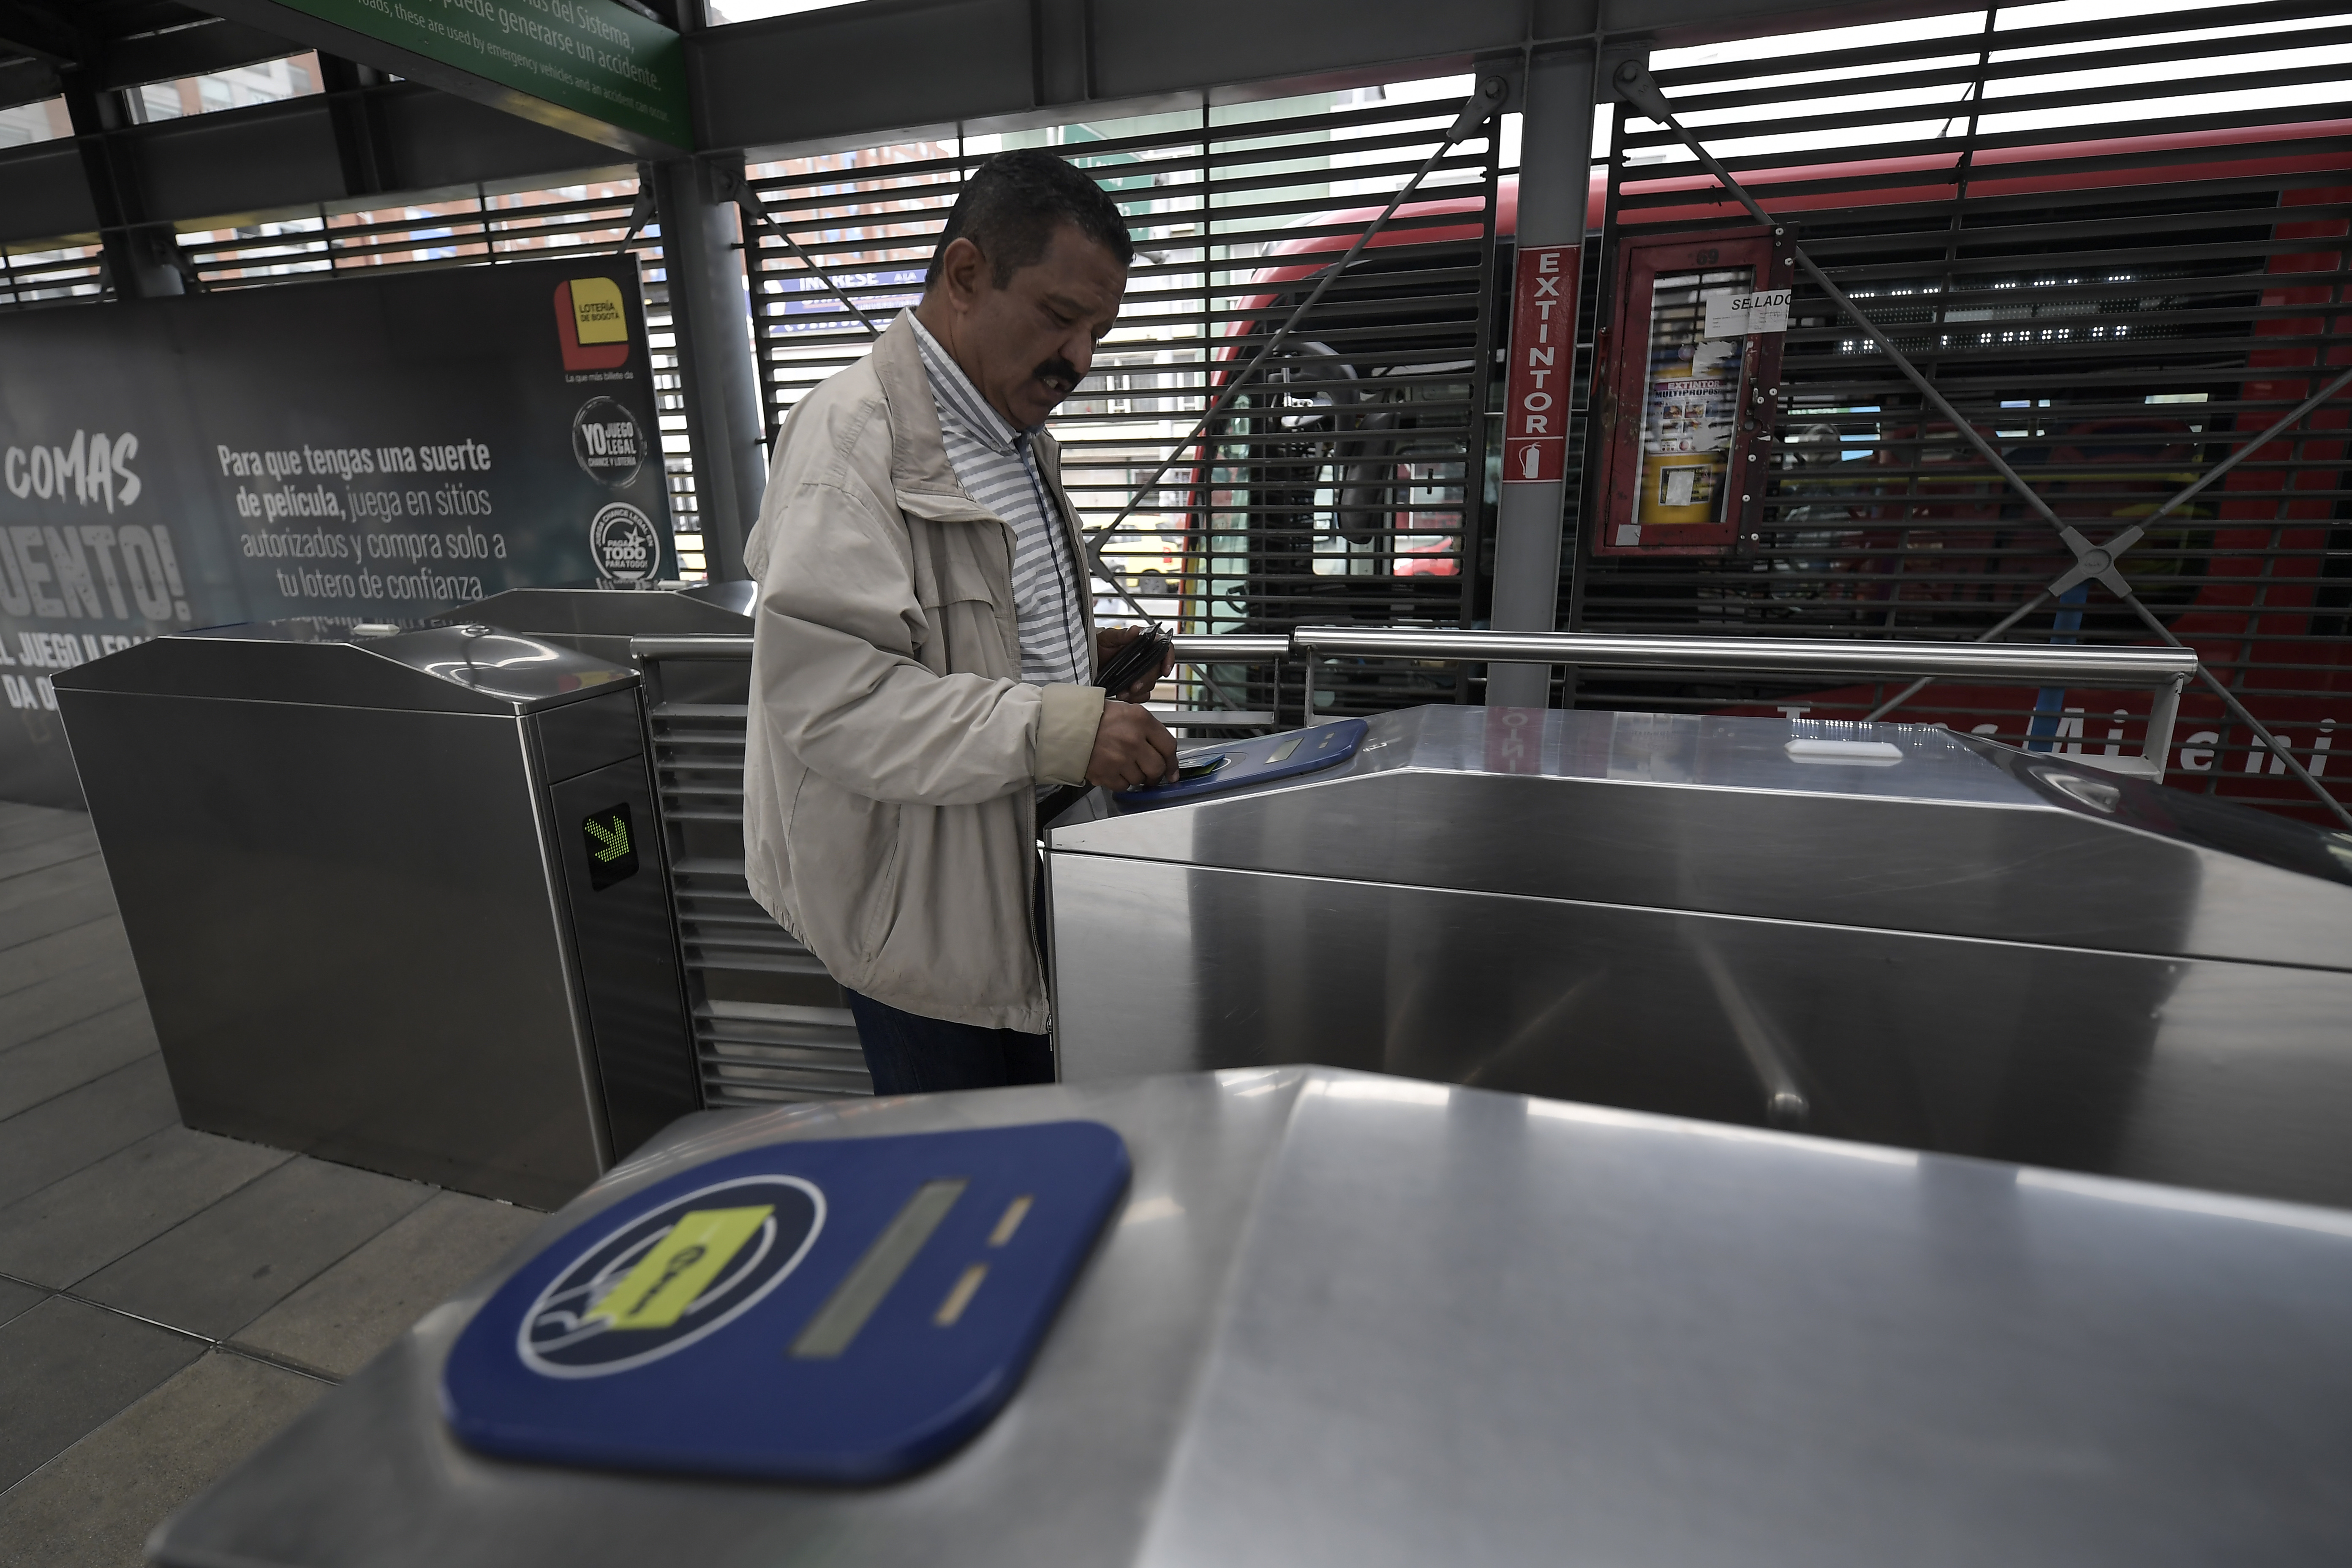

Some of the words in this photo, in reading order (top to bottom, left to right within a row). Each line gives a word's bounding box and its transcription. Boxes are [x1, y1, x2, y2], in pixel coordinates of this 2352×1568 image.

[394, 3, 425, 28] these
[428, 19, 445, 35] are
[447, 27, 471, 45] used
[472, 33, 485, 54] by
[487, 43, 537, 74] emergency
[552, 0, 574, 24] del
[577, 6, 634, 54] Sistema,
[499, 8, 574, 54] generarse
[576, 41, 595, 63] un
[598, 50, 661, 91] accidente.
[579, 300, 615, 313] LOTERÍA
[581, 314, 590, 322] DE
[1524, 253, 1560, 434] EXTINTOR
[1668, 381, 1720, 389] EXTINTOR
[581, 422, 607, 456] YO
[605, 422, 634, 438] JUEGO
[606, 438, 637, 455] LEGAL
[5, 429, 142, 514] COMAS
[217, 444, 263, 477] Para
[264, 450, 301, 482] que
[303, 444, 375, 481] tengas
[376, 446, 418, 473] una
[419, 438, 492, 472] suerte
[236, 485, 262, 517] de
[262, 485, 346, 523] película,
[346, 485, 403, 523] juega
[406, 491, 433, 516] en
[435, 482, 492, 516] sitios
[240, 526, 349, 559] autorizados
[350, 534, 362, 565] y
[366, 532, 443, 564] compra
[446, 525, 489, 559] solo
[492, 533, 507, 559] a
[603, 546, 647, 560] TODO
[276, 567, 299, 597] tu
[298, 566, 356, 599] lotero
[359, 567, 384, 599] de
[18, 632, 84, 669] JUEGO
